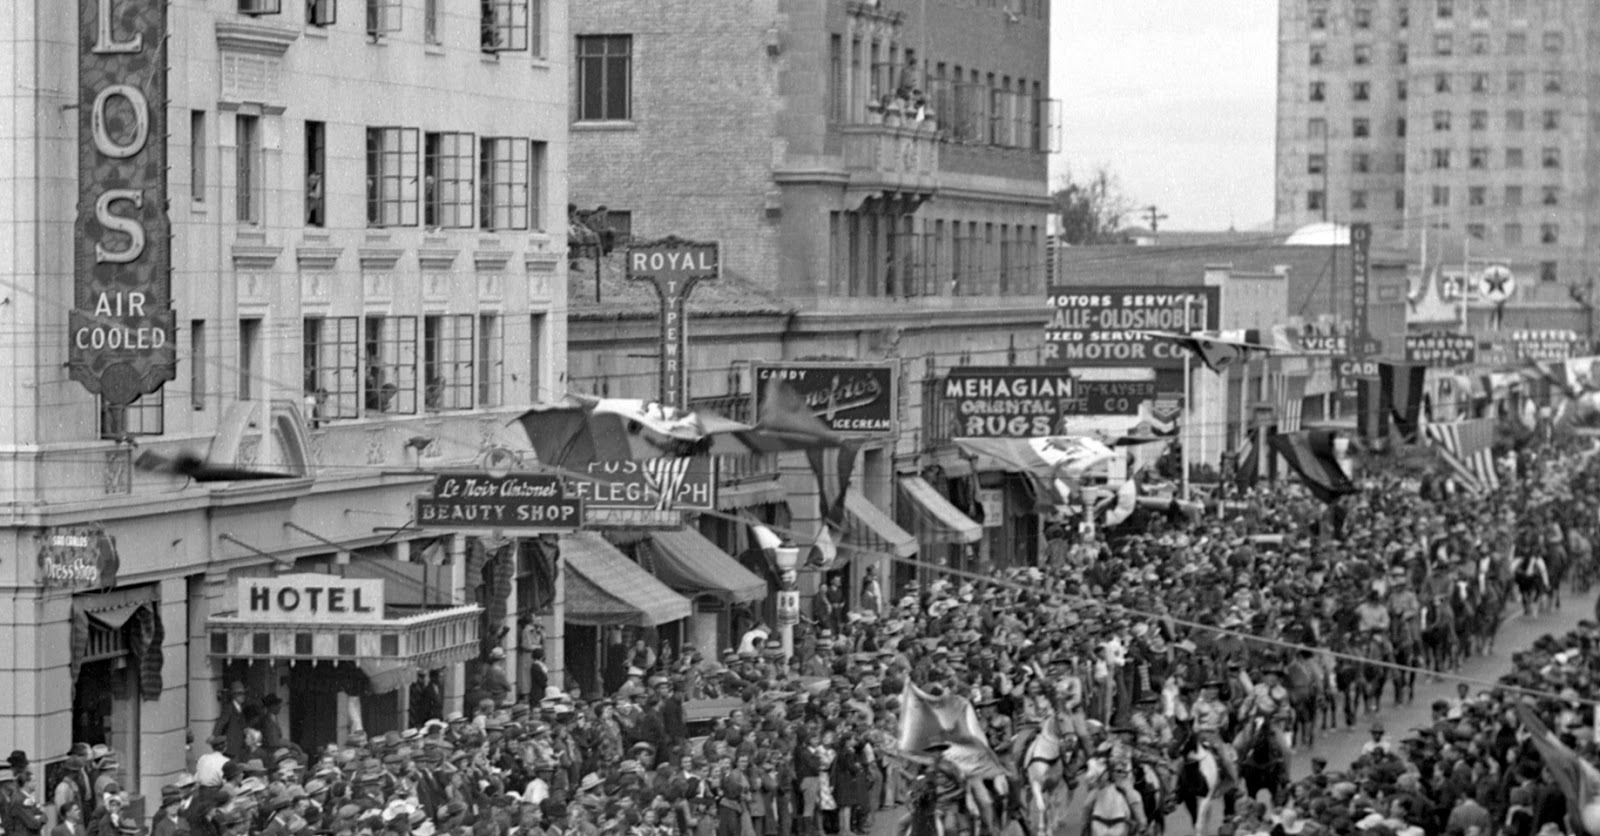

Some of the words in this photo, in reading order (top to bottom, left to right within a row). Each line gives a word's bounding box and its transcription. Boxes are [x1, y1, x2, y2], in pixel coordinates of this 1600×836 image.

[633, 251, 711, 271] ROYAL
[94, 292, 146, 317] AIR
[76, 327, 165, 350] COOLED
[1066, 342, 1146, 359] MOTOR
[760, 369, 807, 380] CANDY
[946, 378, 1073, 397] MEHAGIAN
[960, 400, 1056, 415] ORIENTAL
[1104, 398, 1129, 411] CO
[832, 418, 850, 429] ICE
[852, 418, 890, 429] CREAM
[966, 415, 1051, 436] RUGS
[439, 478, 460, 498] Le
[422, 504, 506, 520] BEAUTY
[516, 504, 575, 521] SHOP
[250, 586, 372, 612] HOTEL
